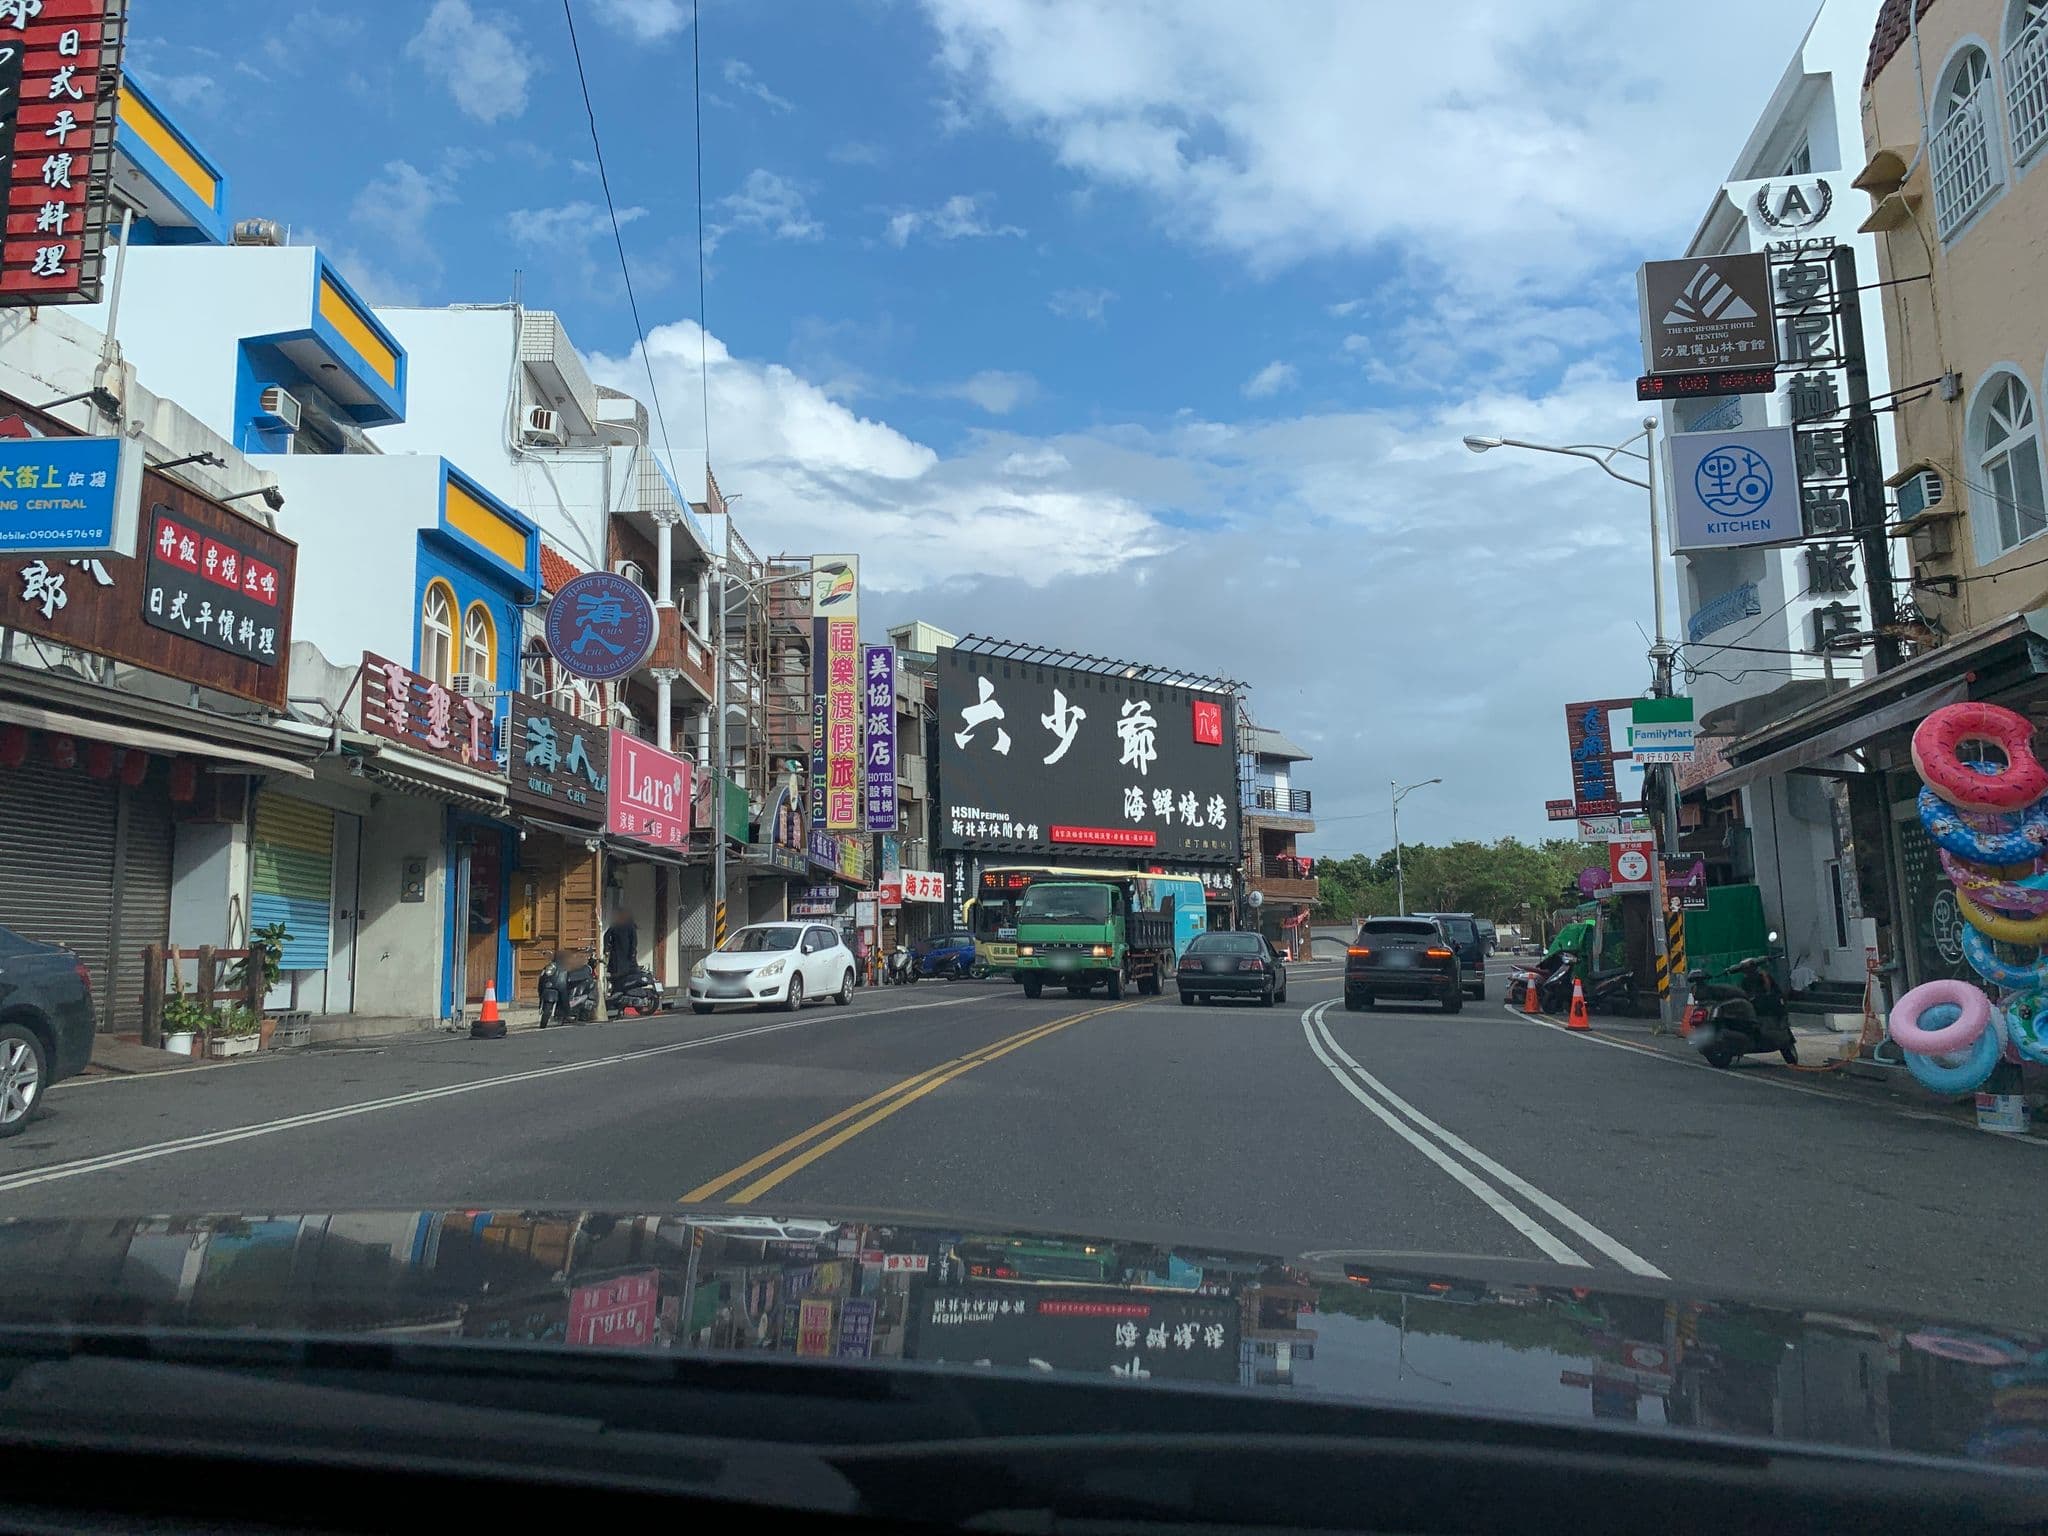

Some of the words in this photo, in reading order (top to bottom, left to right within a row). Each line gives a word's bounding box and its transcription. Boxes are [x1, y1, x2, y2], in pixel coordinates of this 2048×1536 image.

[31, 29, 83, 278] 日式平價料理
[1684, 324, 1729, 333] RICHFOREST
[1695, 332, 1729, 340] KENTING
[26, 499, 87, 510] CENTRAL
[1707, 519, 1771, 534] KITCHEN
[150, 587, 276, 656] 日式平價料理
[830, 622, 857, 824] 福樂渡假旅店
[867, 653, 892, 767] 美協旅店
[954, 676, 1157, 775] 六少爺
[814, 693, 827, 763] Formost
[1634, 729, 1693, 740] FamilyMart
[1635, 752, 1694, 762] 前行50公尺
[628, 750, 674, 813] Lara
[868, 773, 894, 782] HOTEL
[813, 774, 826, 822] Hotel
[951, 806, 980, 820] HSIN
[980, 811, 1010, 821] PEIPING
[1124, 785, 1227, 830] 海鮮燒烤
[906, 873, 943, 899] 海方苑
